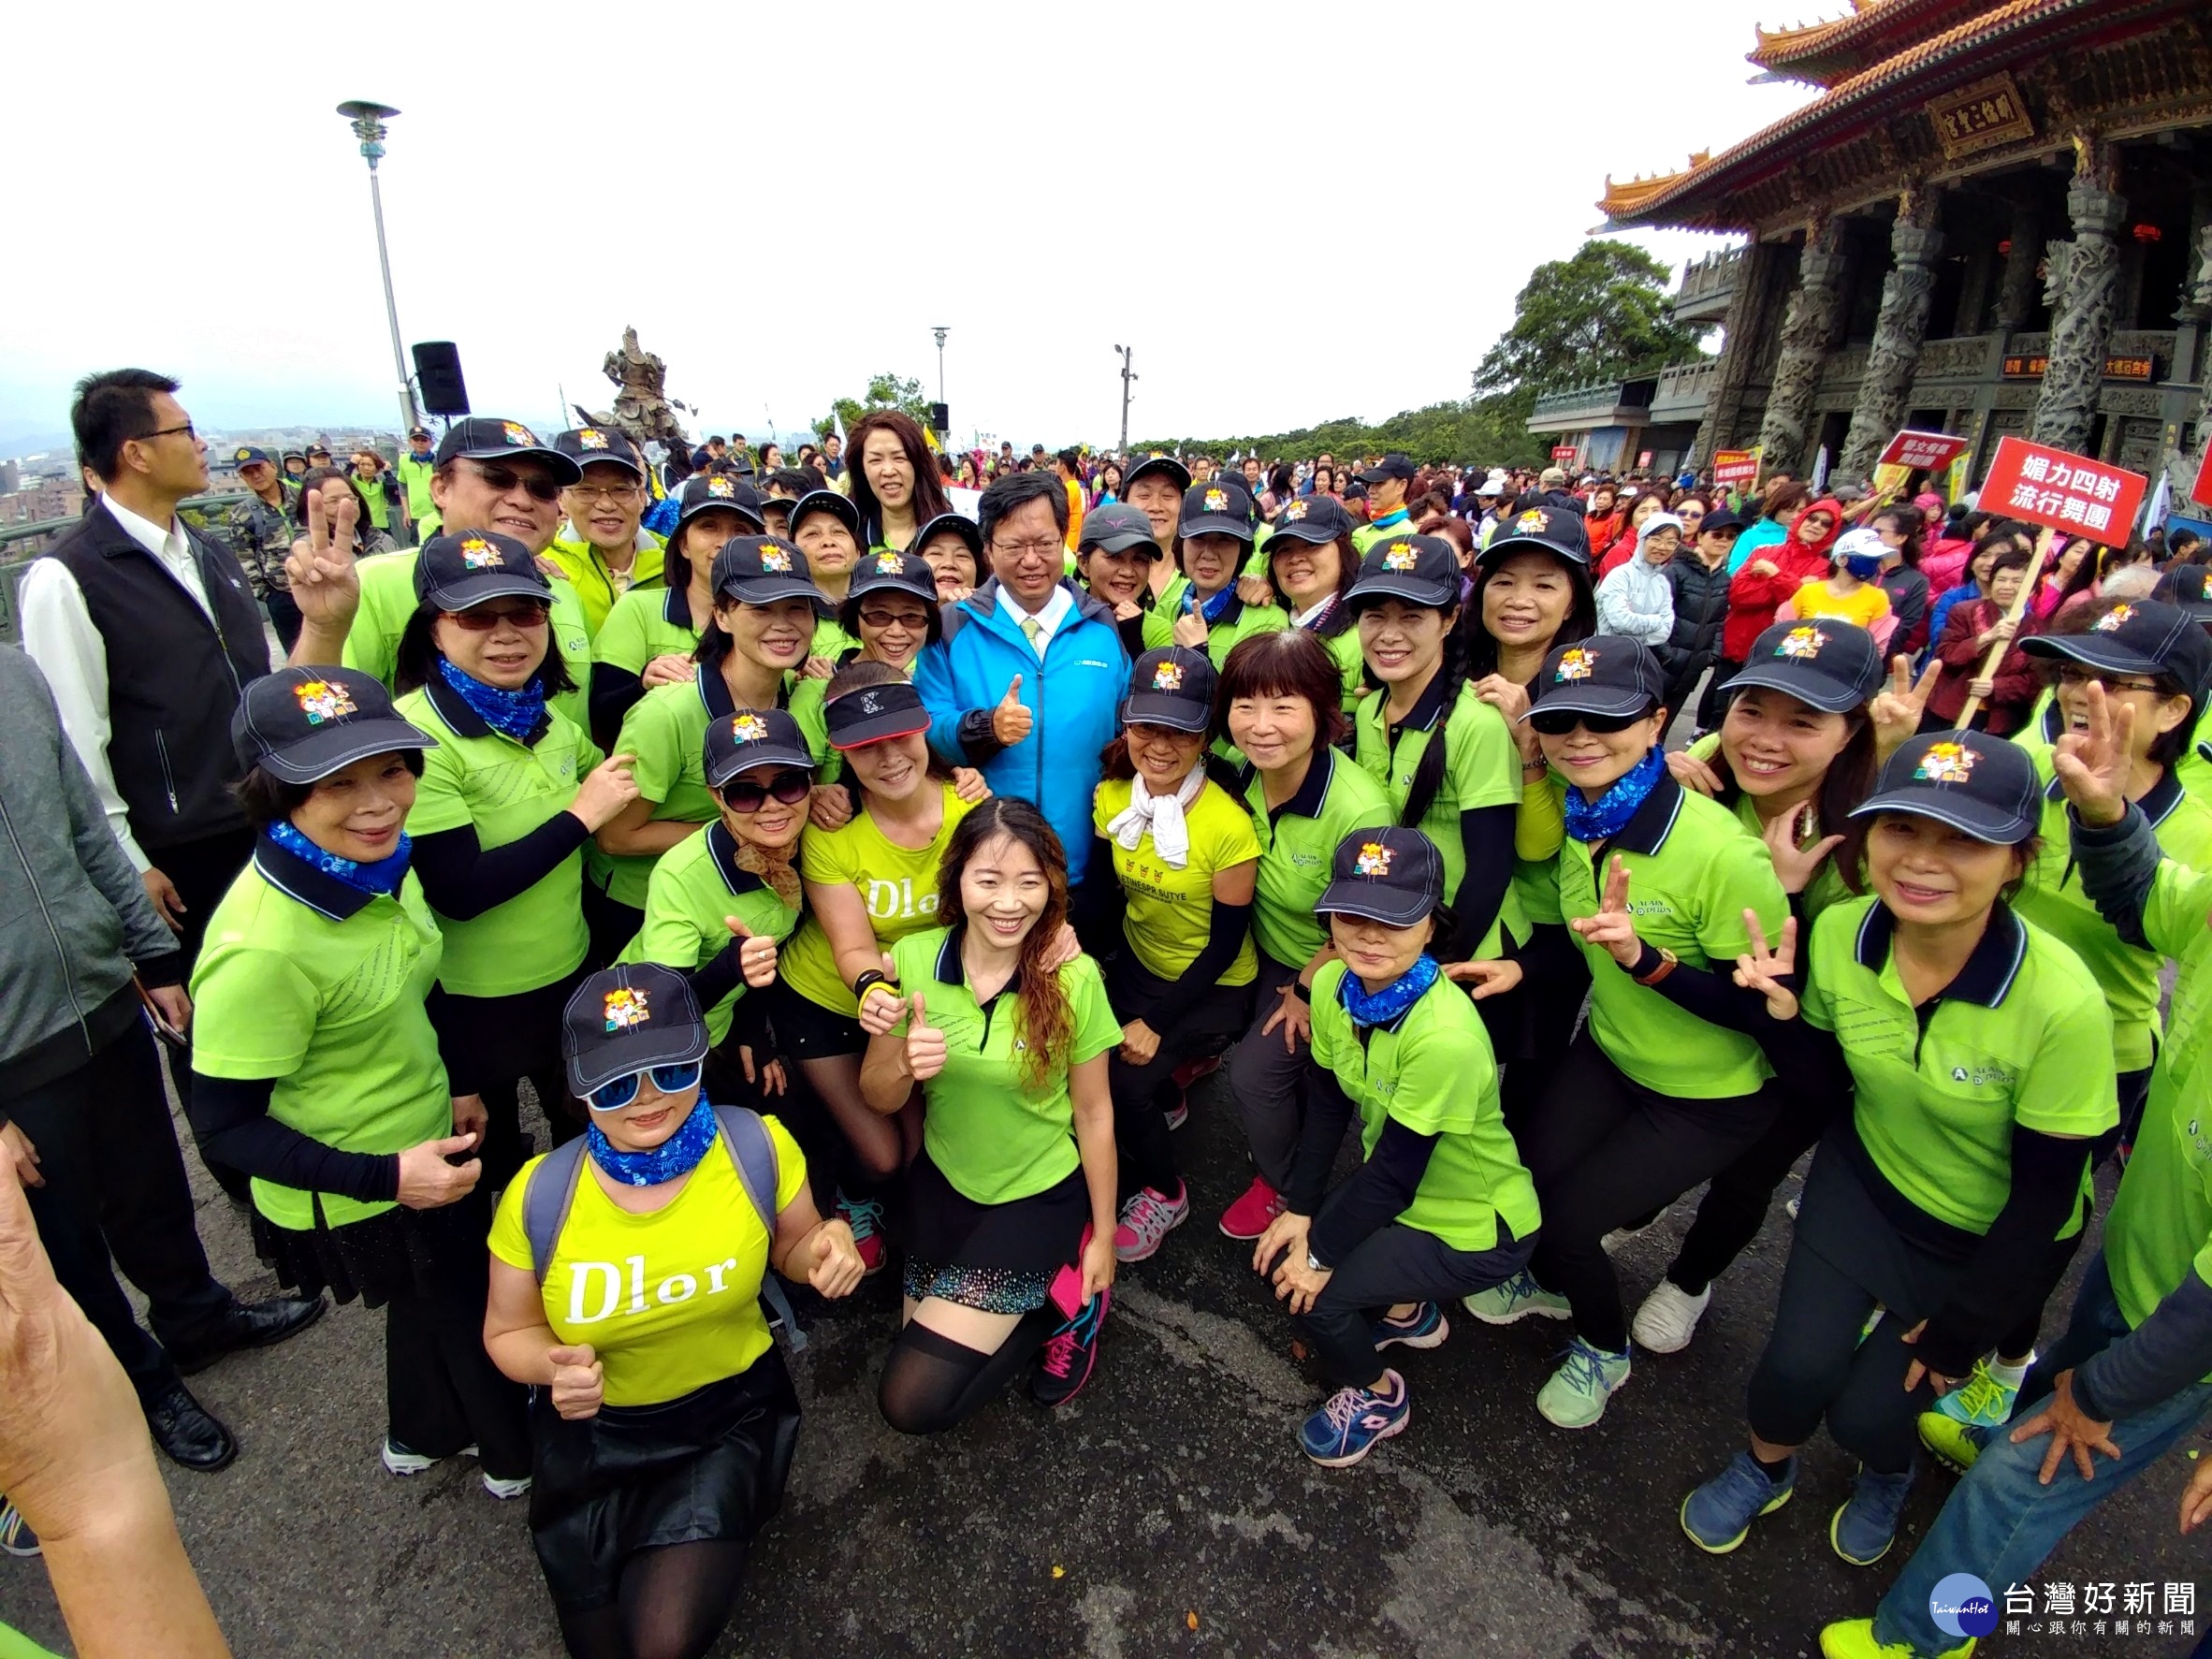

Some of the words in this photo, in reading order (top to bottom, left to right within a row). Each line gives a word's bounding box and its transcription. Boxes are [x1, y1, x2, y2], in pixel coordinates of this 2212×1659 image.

[2020, 454, 2120, 502] 媚力四射
[2009, 483, 2112, 531] 流行舞團
